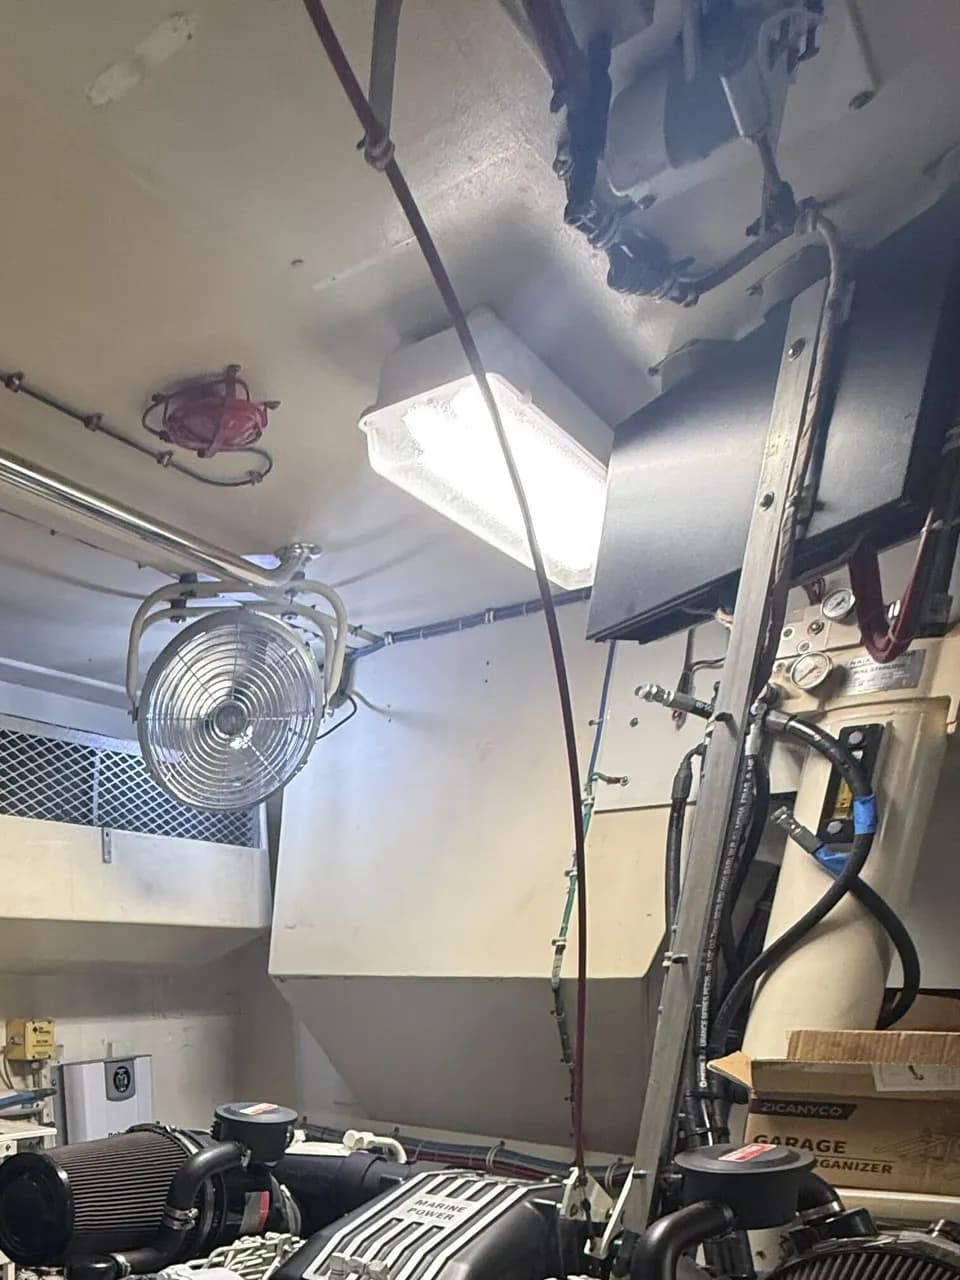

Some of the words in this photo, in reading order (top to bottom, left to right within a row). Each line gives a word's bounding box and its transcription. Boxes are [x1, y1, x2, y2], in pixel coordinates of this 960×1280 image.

[761, 1103, 843, 1116] ZICANYCO
[414, 1200, 468, 1212] MARINE
[406, 1208, 455, 1221] POWER
